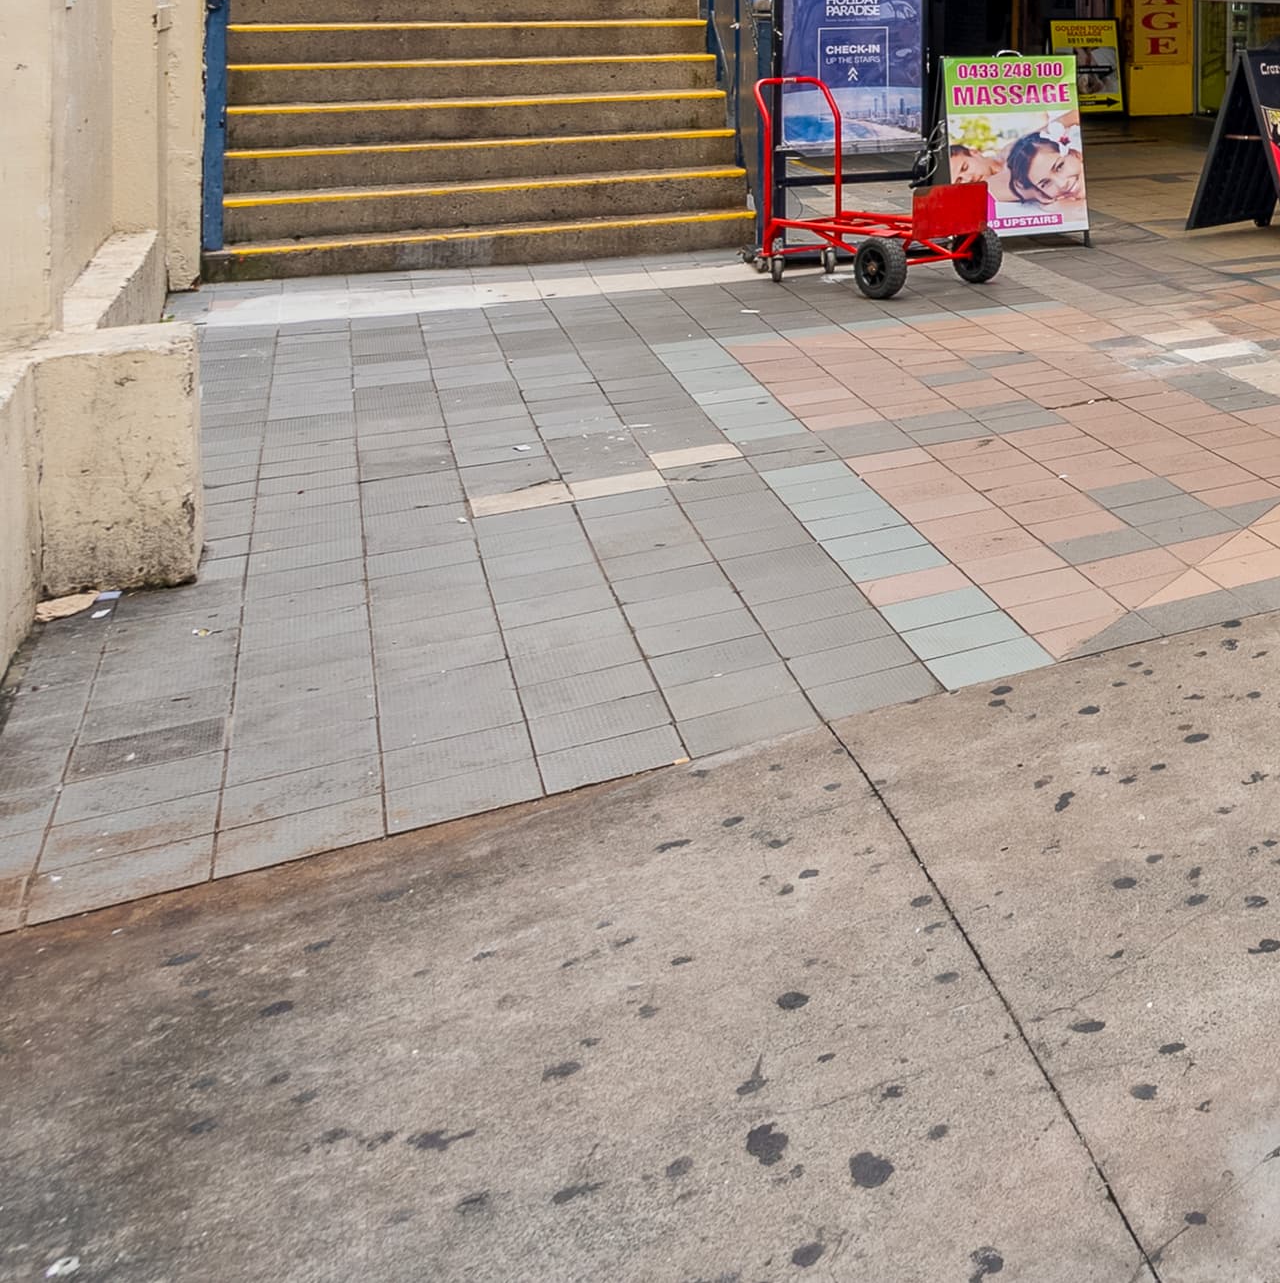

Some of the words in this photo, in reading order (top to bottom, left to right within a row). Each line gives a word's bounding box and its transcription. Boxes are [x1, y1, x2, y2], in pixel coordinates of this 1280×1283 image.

[826, 5, 880, 16] PARADISE
[826, 45, 880, 54] CHECK-IN
[826, 56, 838, 64] UP
[838, 56, 852, 64] THE
[854, 55, 880, 64] STAIRS
[958, 64, 999, 80] 0433
[1003, 63, 1032, 78] 248
[1036, 62, 1063, 78] 100
[953, 83, 1070, 107] MASSAGE
[1003, 215, 1058, 228] UPSTAIRS
